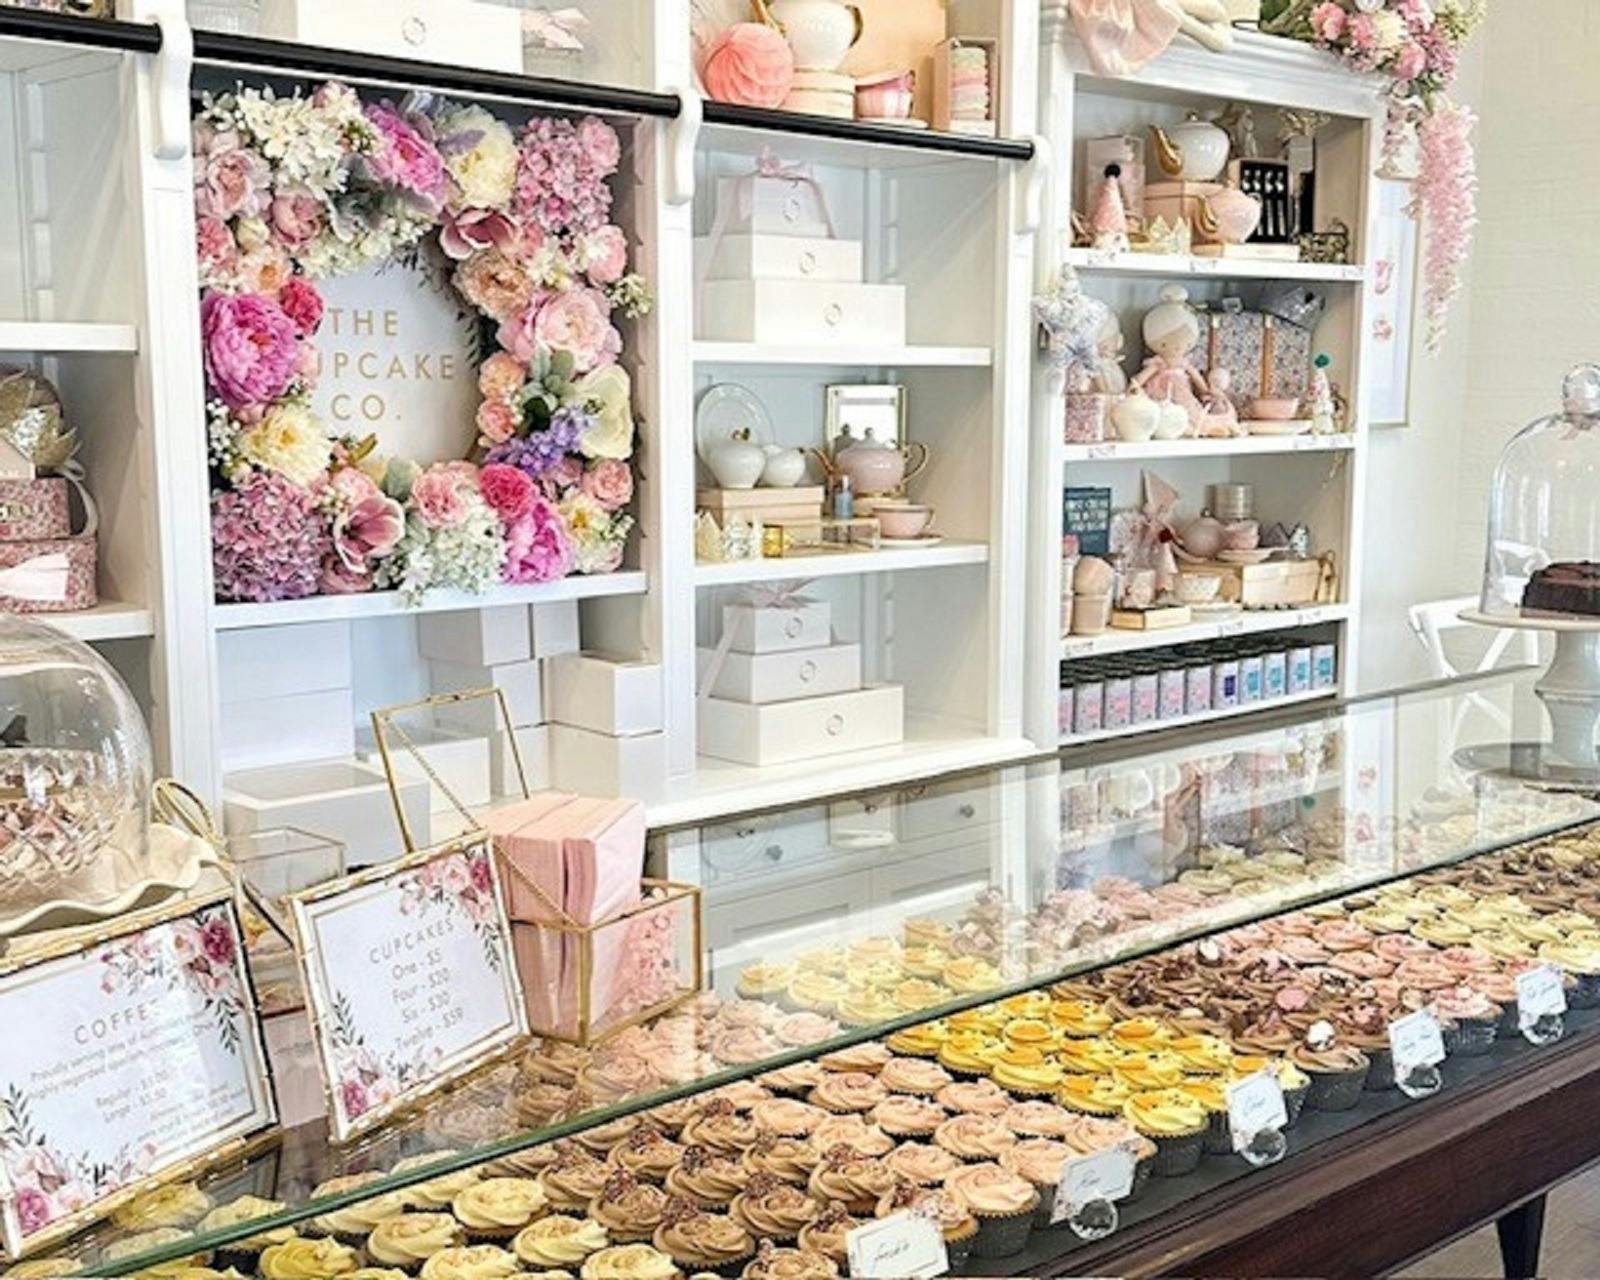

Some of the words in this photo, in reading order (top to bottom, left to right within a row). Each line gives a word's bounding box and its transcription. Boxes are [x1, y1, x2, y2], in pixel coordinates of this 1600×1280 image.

[327, 308, 399, 336] THE
[315, 352, 455, 380] PCAKE
[331, 394, 402, 421] CO.
[369, 918, 454, 964] CUPCAKES
[392, 962, 418, 981] One
